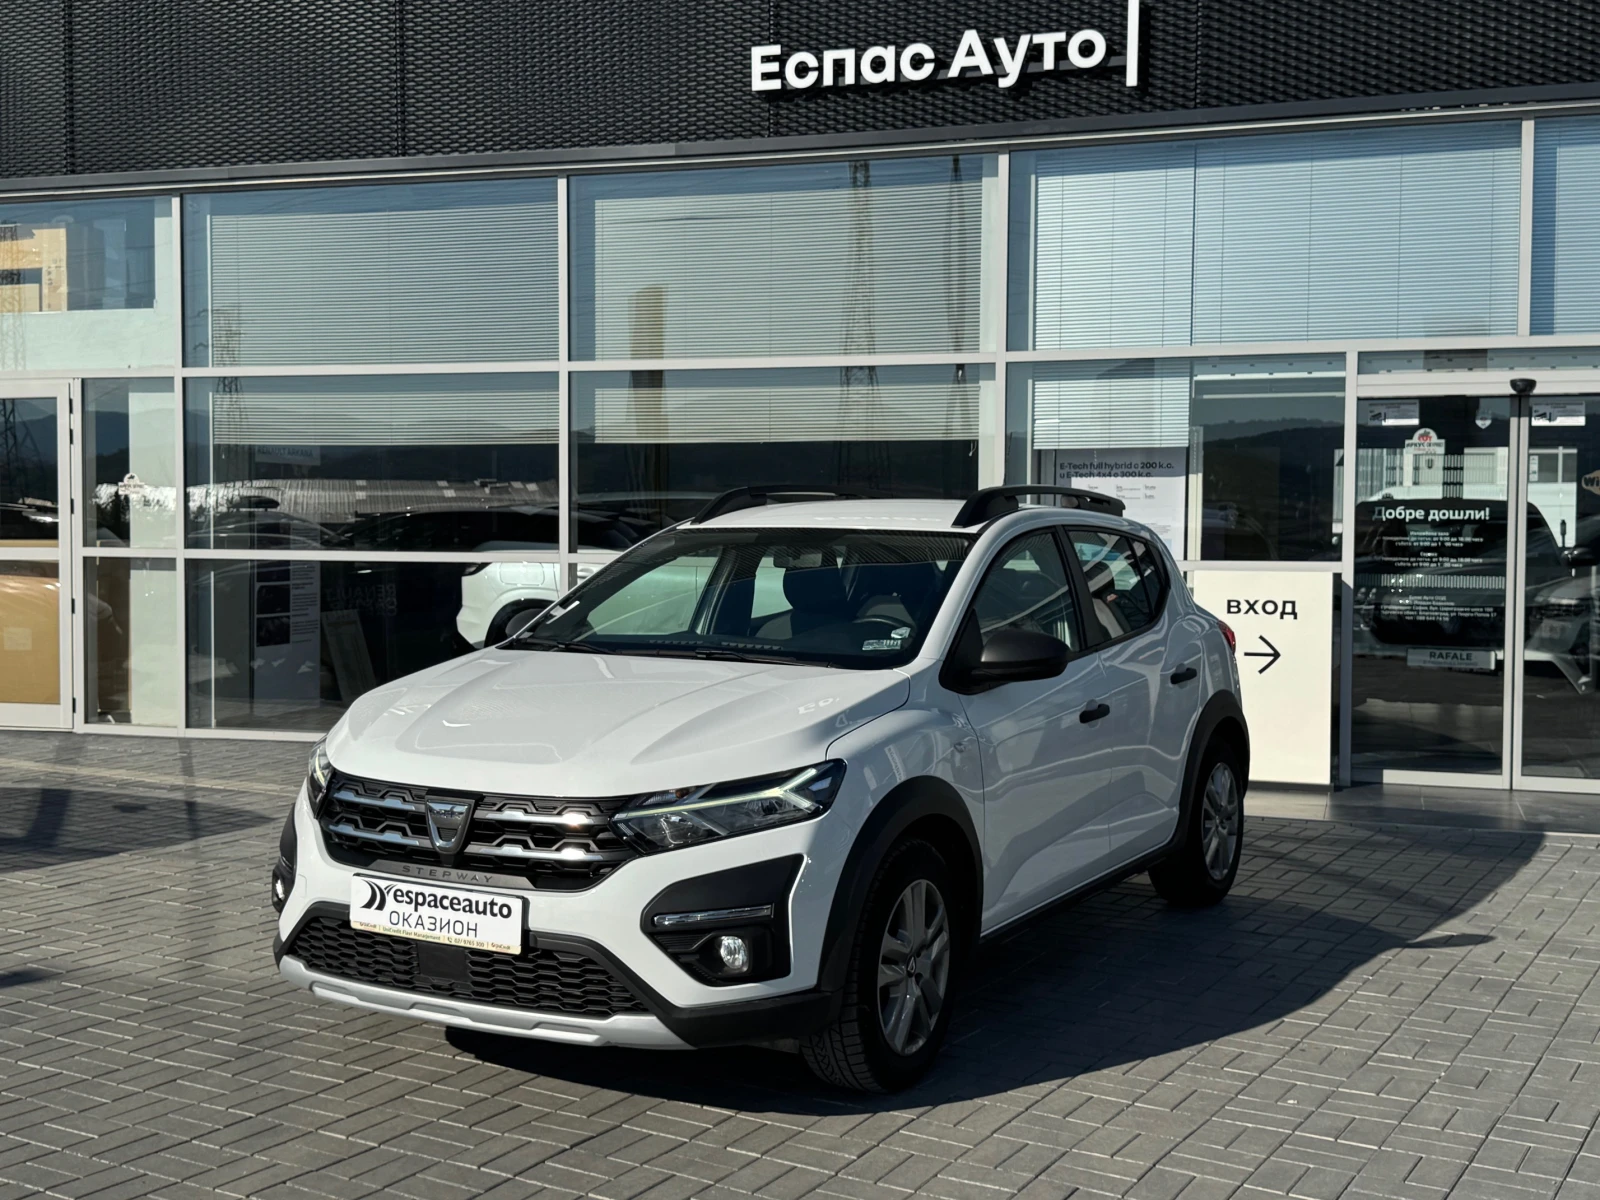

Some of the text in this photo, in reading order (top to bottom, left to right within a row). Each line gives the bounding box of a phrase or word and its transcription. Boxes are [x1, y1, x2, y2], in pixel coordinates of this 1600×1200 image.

[751, 28, 1107, 92] Еспас Ауто
[1059, 462, 1089, 470] E-Tech
[1089, 461, 1103, 470] full
[1104, 461, 1132, 472] hybrid
[1372, 506, 1490, 522] Добре дошли!
[1429, 651, 1473, 661] RAFALE
[402, 865, 493, 883] STEPWAY
[393, 887, 512, 919] espaceauto
[389, 910, 478, 939] ОКАЗИОН
